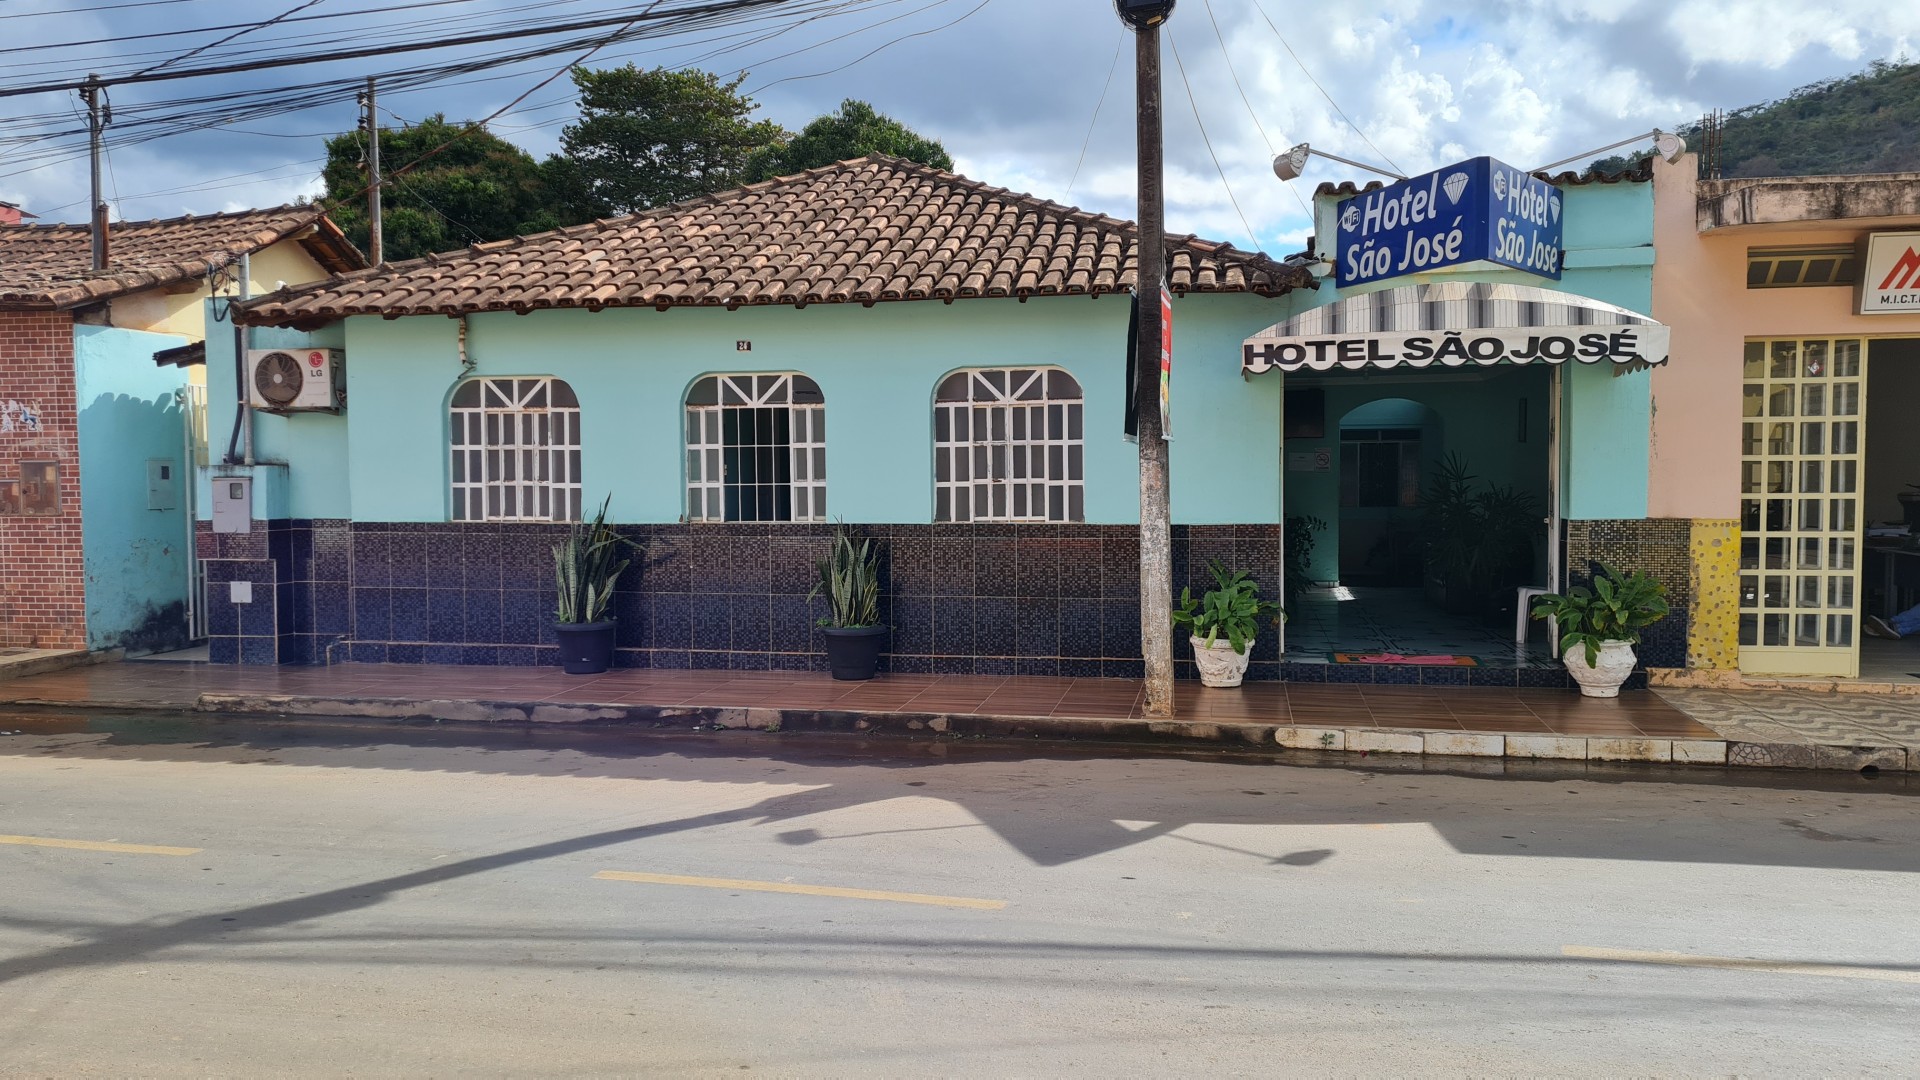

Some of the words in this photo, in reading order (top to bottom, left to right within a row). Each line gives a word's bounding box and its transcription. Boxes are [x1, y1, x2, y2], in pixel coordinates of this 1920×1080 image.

[1362, 171, 1440, 236] Hotel
[1507, 170, 1548, 228] Hotel
[1345, 238, 1392, 281] São
[1398, 215, 1463, 271] José
[1495, 217, 1525, 264] São
[1527, 235, 1558, 274] José
[1880, 294, 1920, 304] M.I.C.T.
[310, 369, 323, 377] LG
[1243, 339, 1396, 366] HOTEL
[1402, 331, 1505, 361] SÃO
[1510, 328, 1638, 360] JOSÉ
